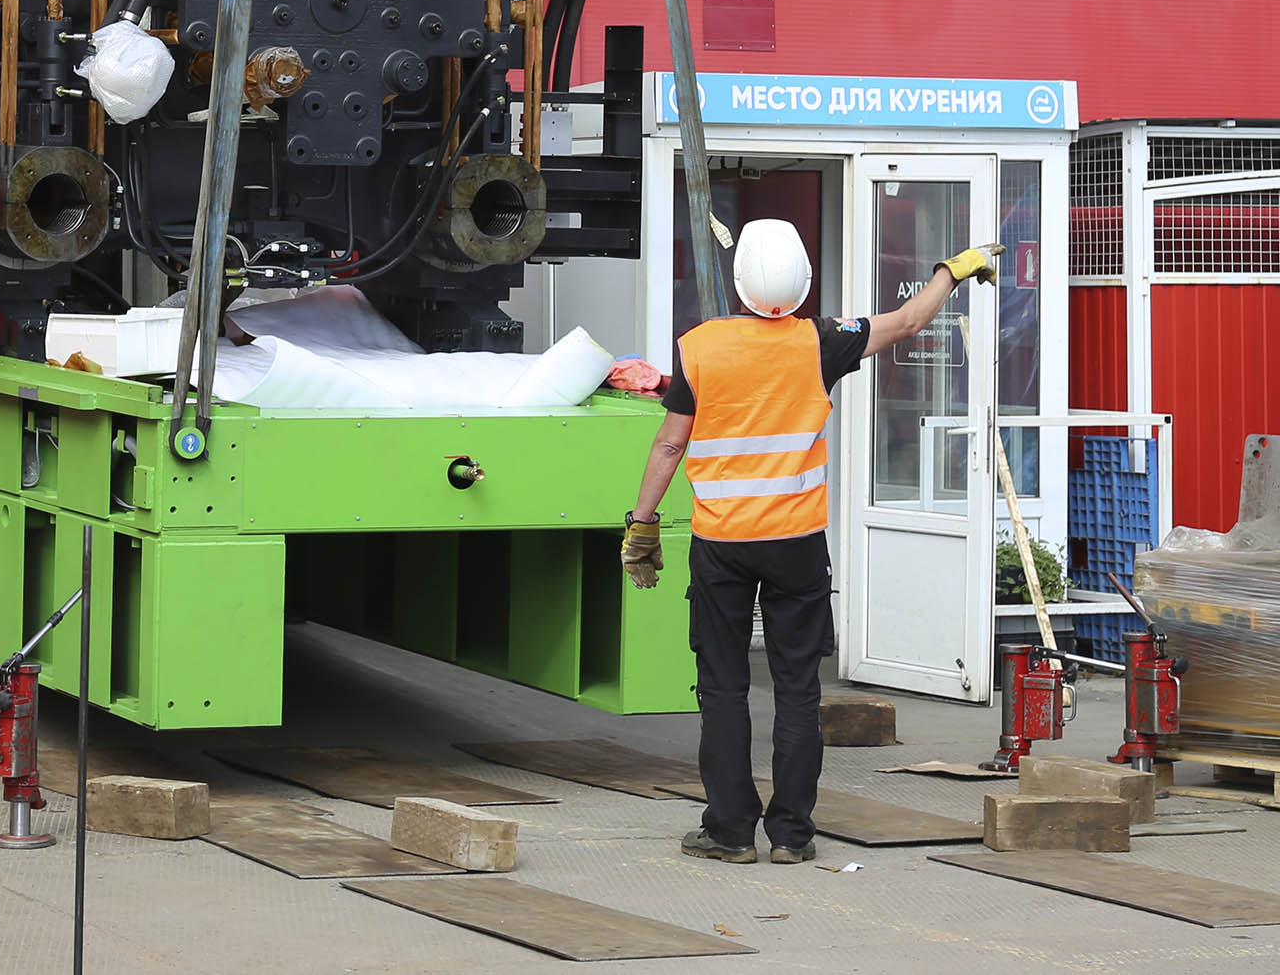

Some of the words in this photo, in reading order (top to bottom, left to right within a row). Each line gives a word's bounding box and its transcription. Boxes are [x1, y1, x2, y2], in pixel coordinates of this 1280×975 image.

[731, 85, 821, 111] МЕСТО
[828, 88, 882, 115] ДЛЯ
[889, 88, 1002, 114] КУРЕНИЯ
